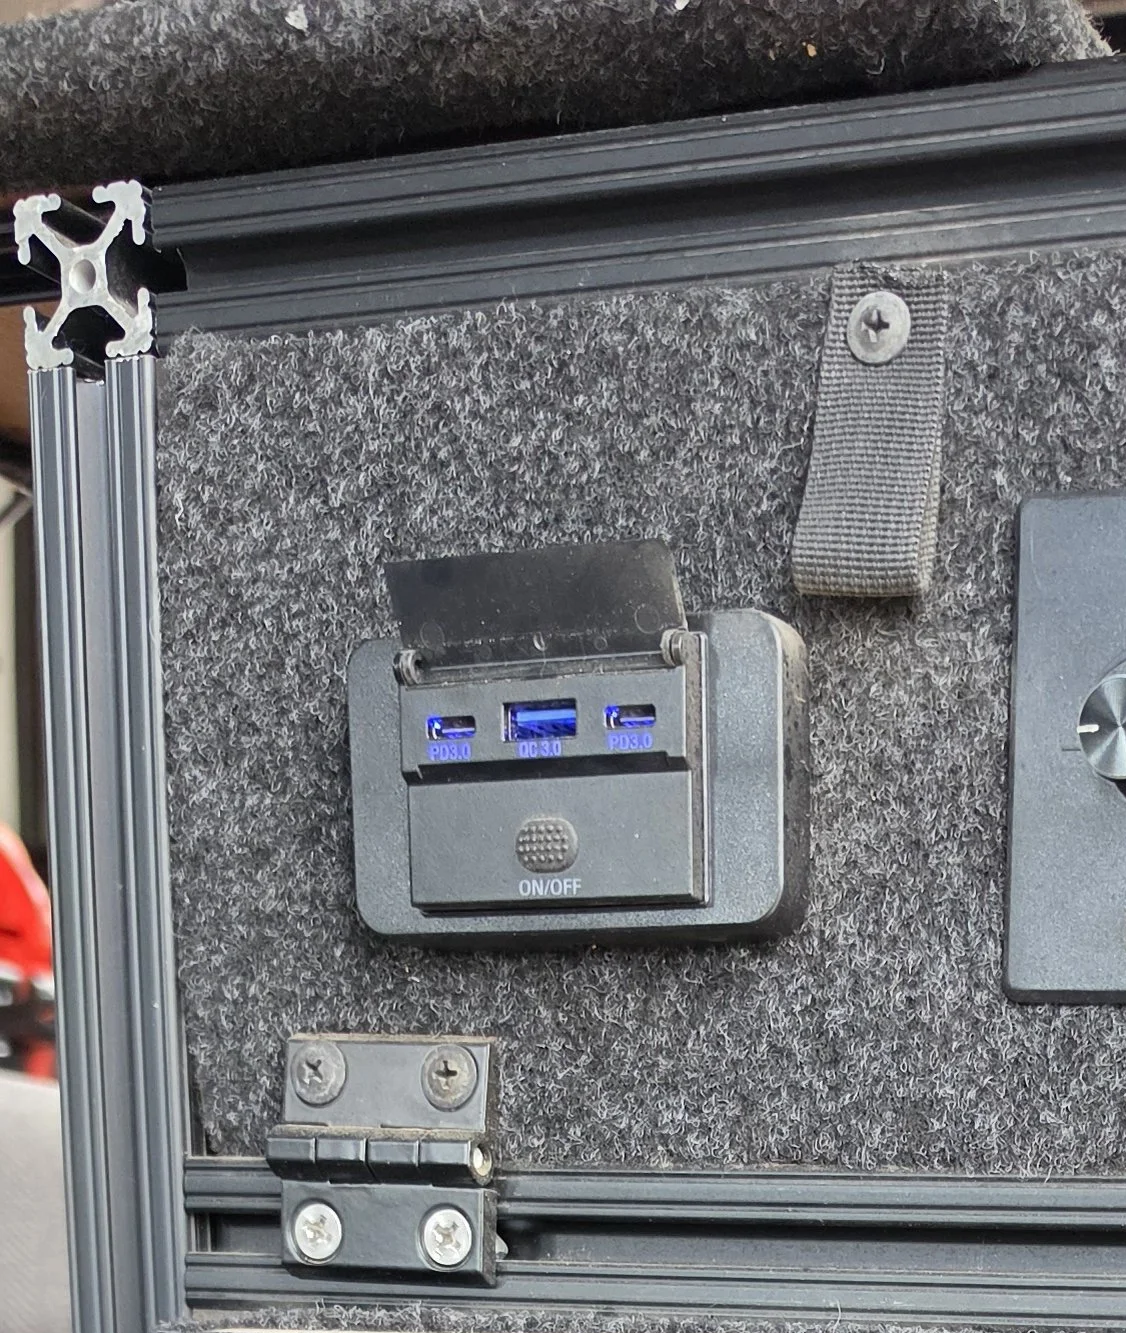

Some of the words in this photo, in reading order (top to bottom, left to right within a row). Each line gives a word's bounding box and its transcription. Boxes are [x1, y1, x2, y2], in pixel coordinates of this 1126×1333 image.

[518, 741, 539, 758] QC
[541, 740, 562, 757] 3.0
[610, 733, 653, 751] PD3.0
[429, 744, 472, 762] PD3.0
[518, 877, 582, 896] ON/OFF
